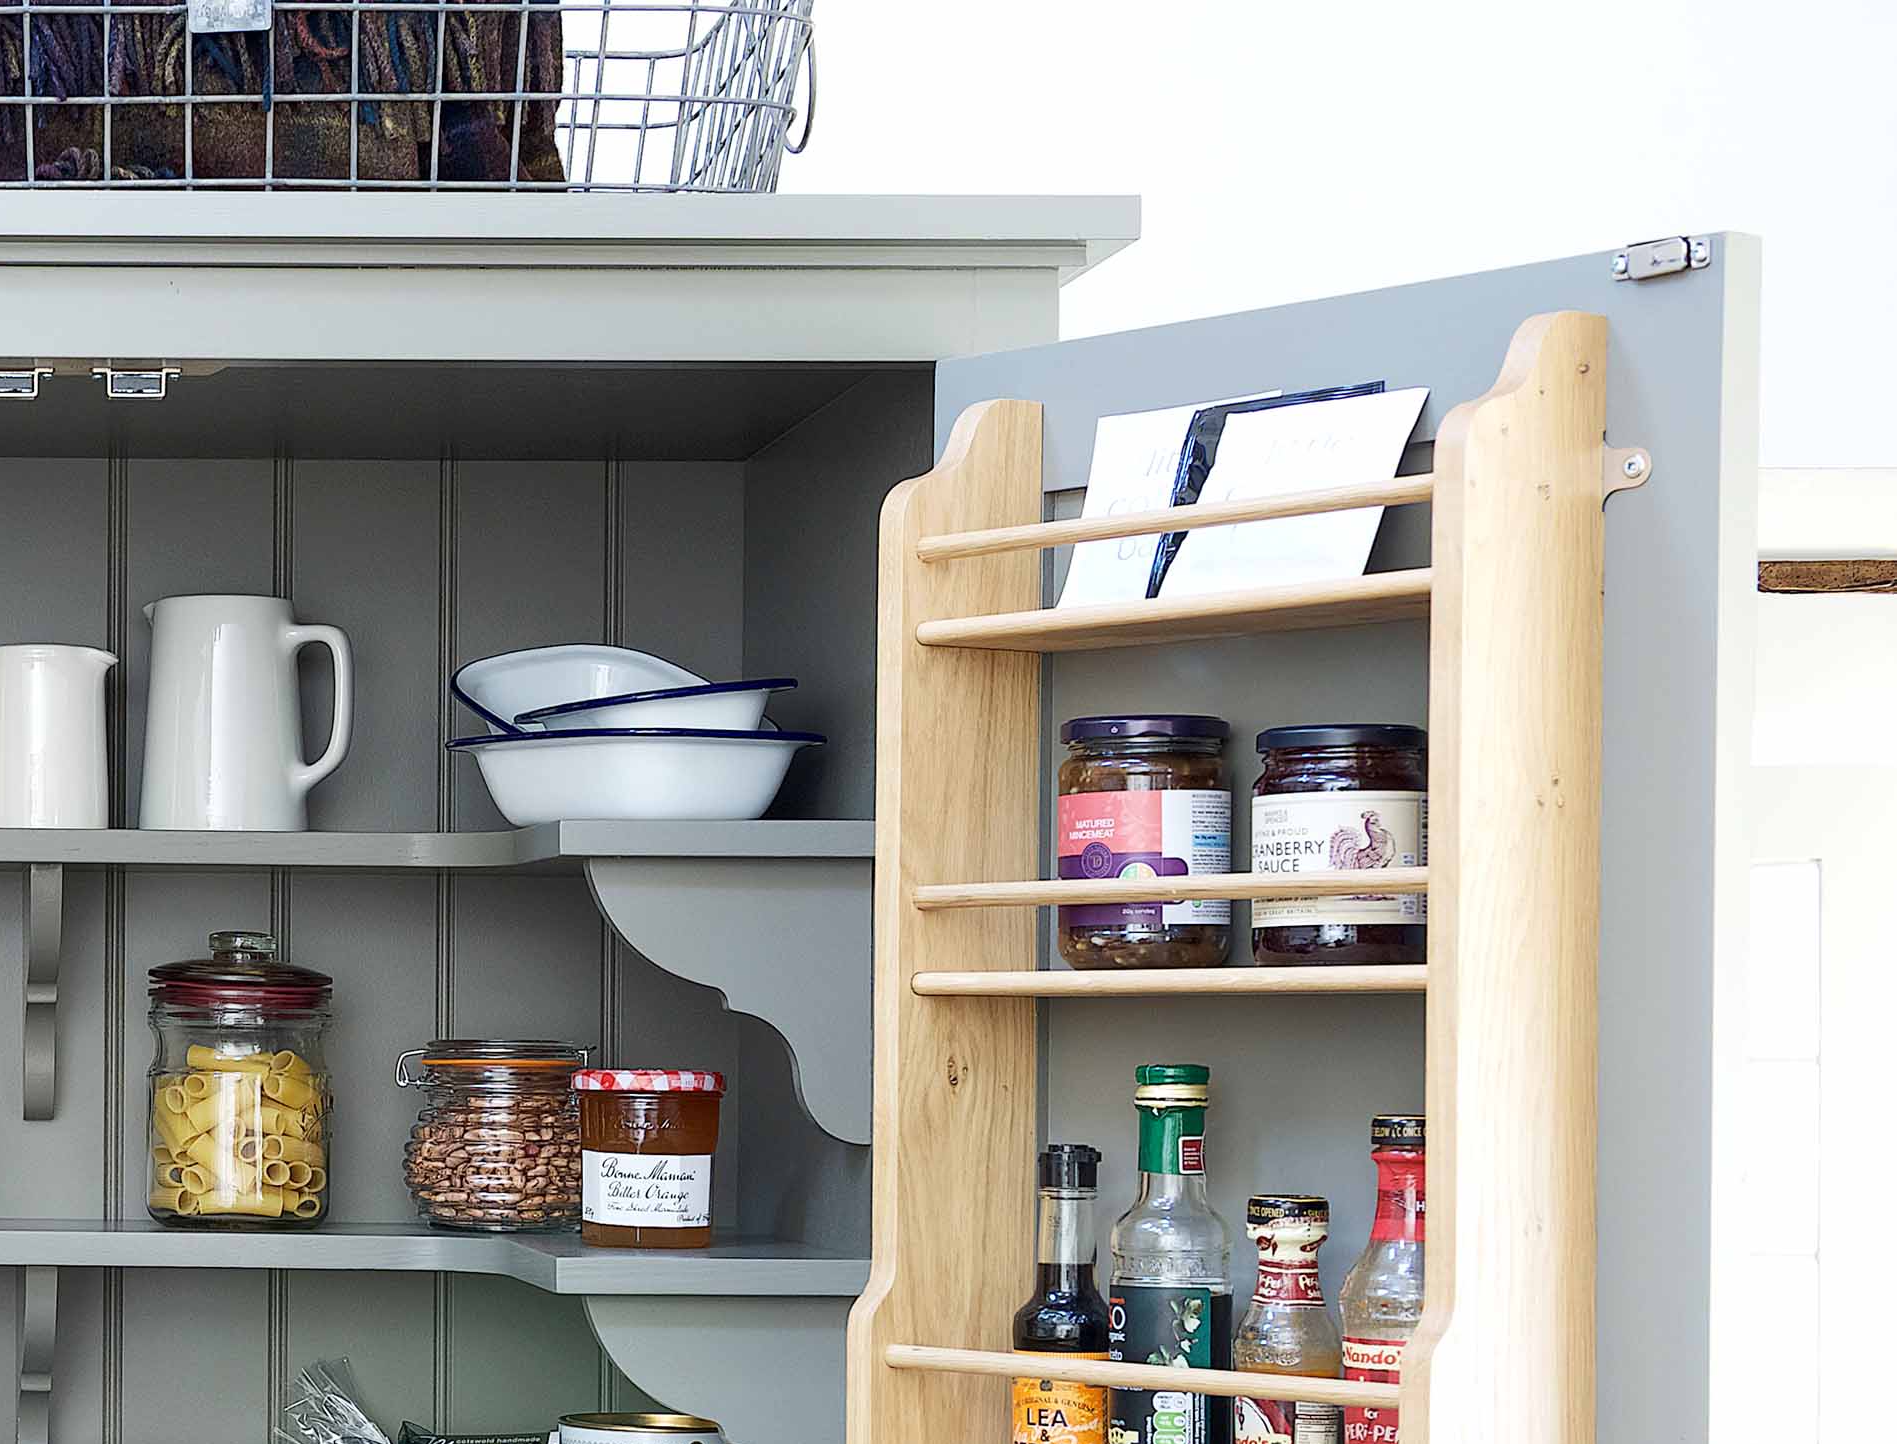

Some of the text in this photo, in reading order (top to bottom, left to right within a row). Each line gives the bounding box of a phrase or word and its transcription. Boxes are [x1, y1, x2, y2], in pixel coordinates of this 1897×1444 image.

[1075, 818, 1115, 830] MATURED
[1069, 829, 1114, 841] MINCEMEAT
[1253, 839, 1325, 859] RANBERRY
[1258, 858, 1300, 874] SAUCE
[601, 1156, 695, 1181] Bonne Maman
[607, 1181, 690, 1207] Bitter Orange
[1026, 1407, 1069, 1427] LEA
[496, 1436, 541, 1444] handmade
[1040, 1429, 1050, 1442] &
